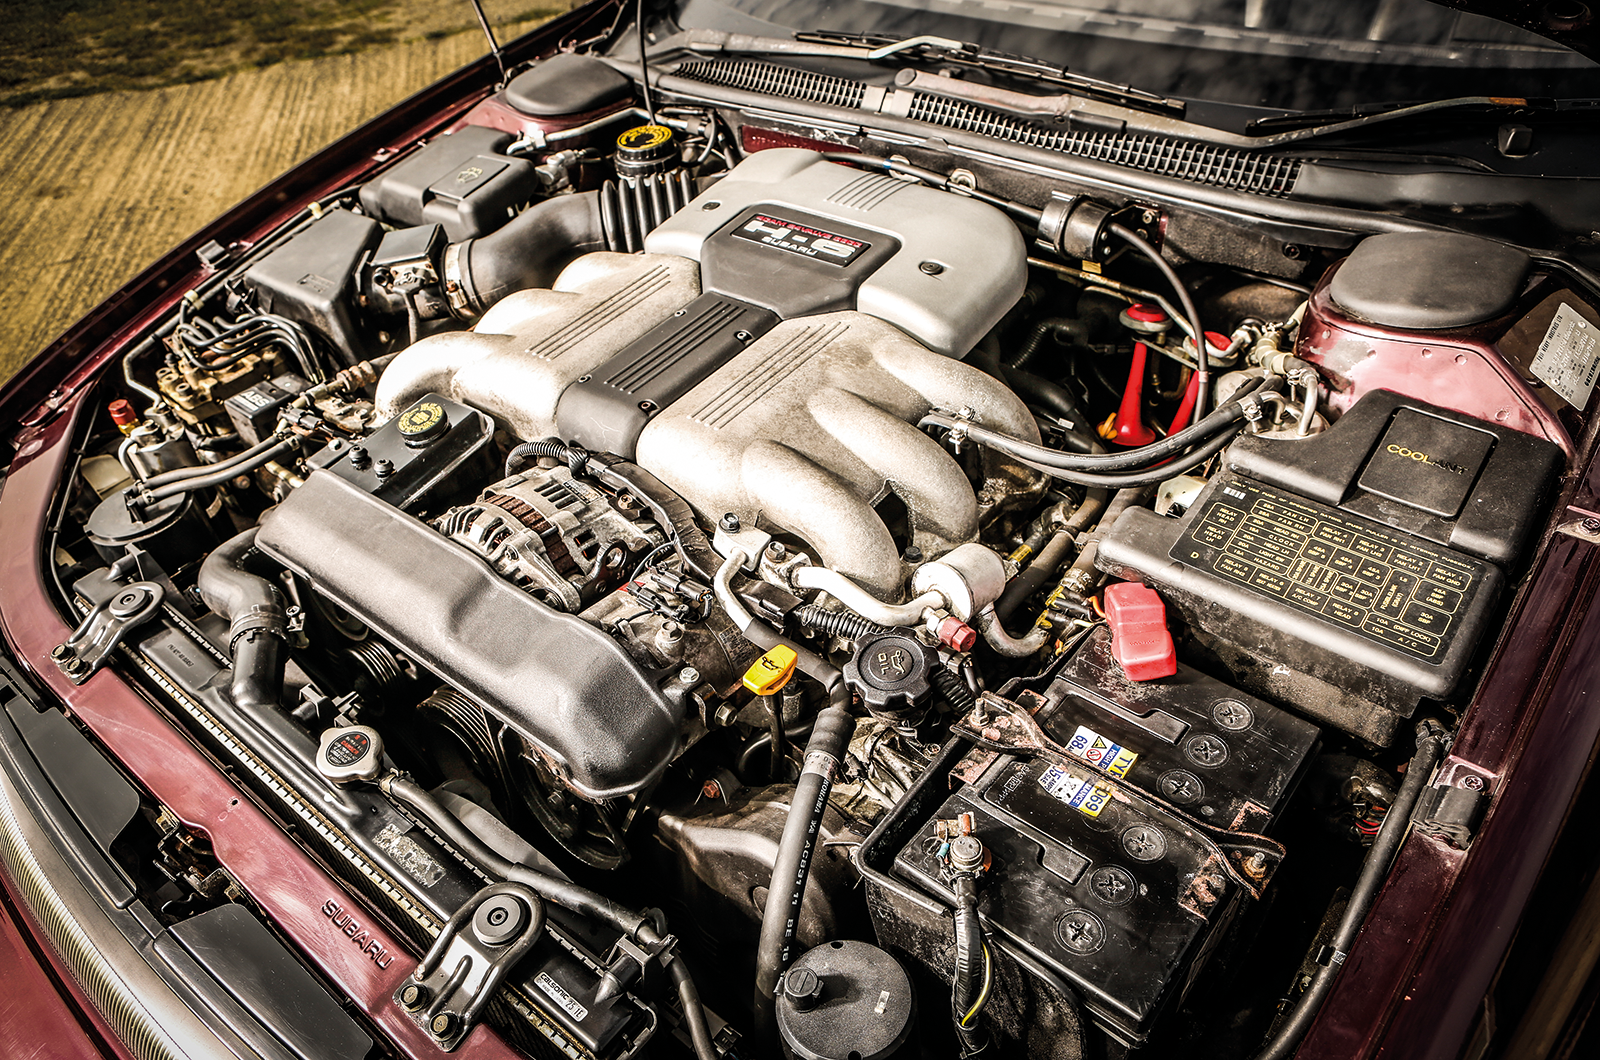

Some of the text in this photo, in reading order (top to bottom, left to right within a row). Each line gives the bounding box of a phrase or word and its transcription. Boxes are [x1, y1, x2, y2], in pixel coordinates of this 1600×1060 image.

[744, 220, 856, 258] H-6
[761, 236, 818, 256] SUBARU
[240, 390, 270, 407] ABS
[1216, 511, 1234, 521] HEAD
[1219, 507, 1237, 516] RELAY
[1282, 509, 1297, 518] FAN
[1277, 516, 1292, 525] FAN
[1203, 529, 1222, 539] HEAD
[1206, 525, 1225, 535] RELAY
[1272, 526, 1289, 535] HEAD
[1318, 530, 1332, 538] FAN
[1322, 526, 1341, 535] RELAY
[1268, 534, 1294, 547] CLOCK
[1358, 539, 1378, 549] RELAY
[1263, 541, 1280, 551] HEAD
[1355, 544, 1369, 552] FAN
[1258, 549, 1275, 558] LIGHT
[1396, 553, 1416, 563] RELAY
[1220, 563, 1233, 571] FAN
[1223, 558, 1242, 568] RELAY
[1253, 557, 1279, 570] HAZARD
[1393, 558, 1407, 566] FAN
[1432, 572, 1446, 580] FAN
[1434, 567, 1455, 577] RELAY
[1258, 572, 1278, 583] RELAY
[1294, 587, 1314, 597] RELAY
[1332, 602, 1352, 613] RELAY
[1333, 609, 1351, 619] HEAD
[877, 652, 890, 675] OIL
[1069, 733, 1089, 751] 68
[1102, 747, 1117, 764] HIGH
[1039, 772, 1051, 785] SAE
[321, 898, 395, 970] SUBARU
[564, 999, 575, 1010] 25
